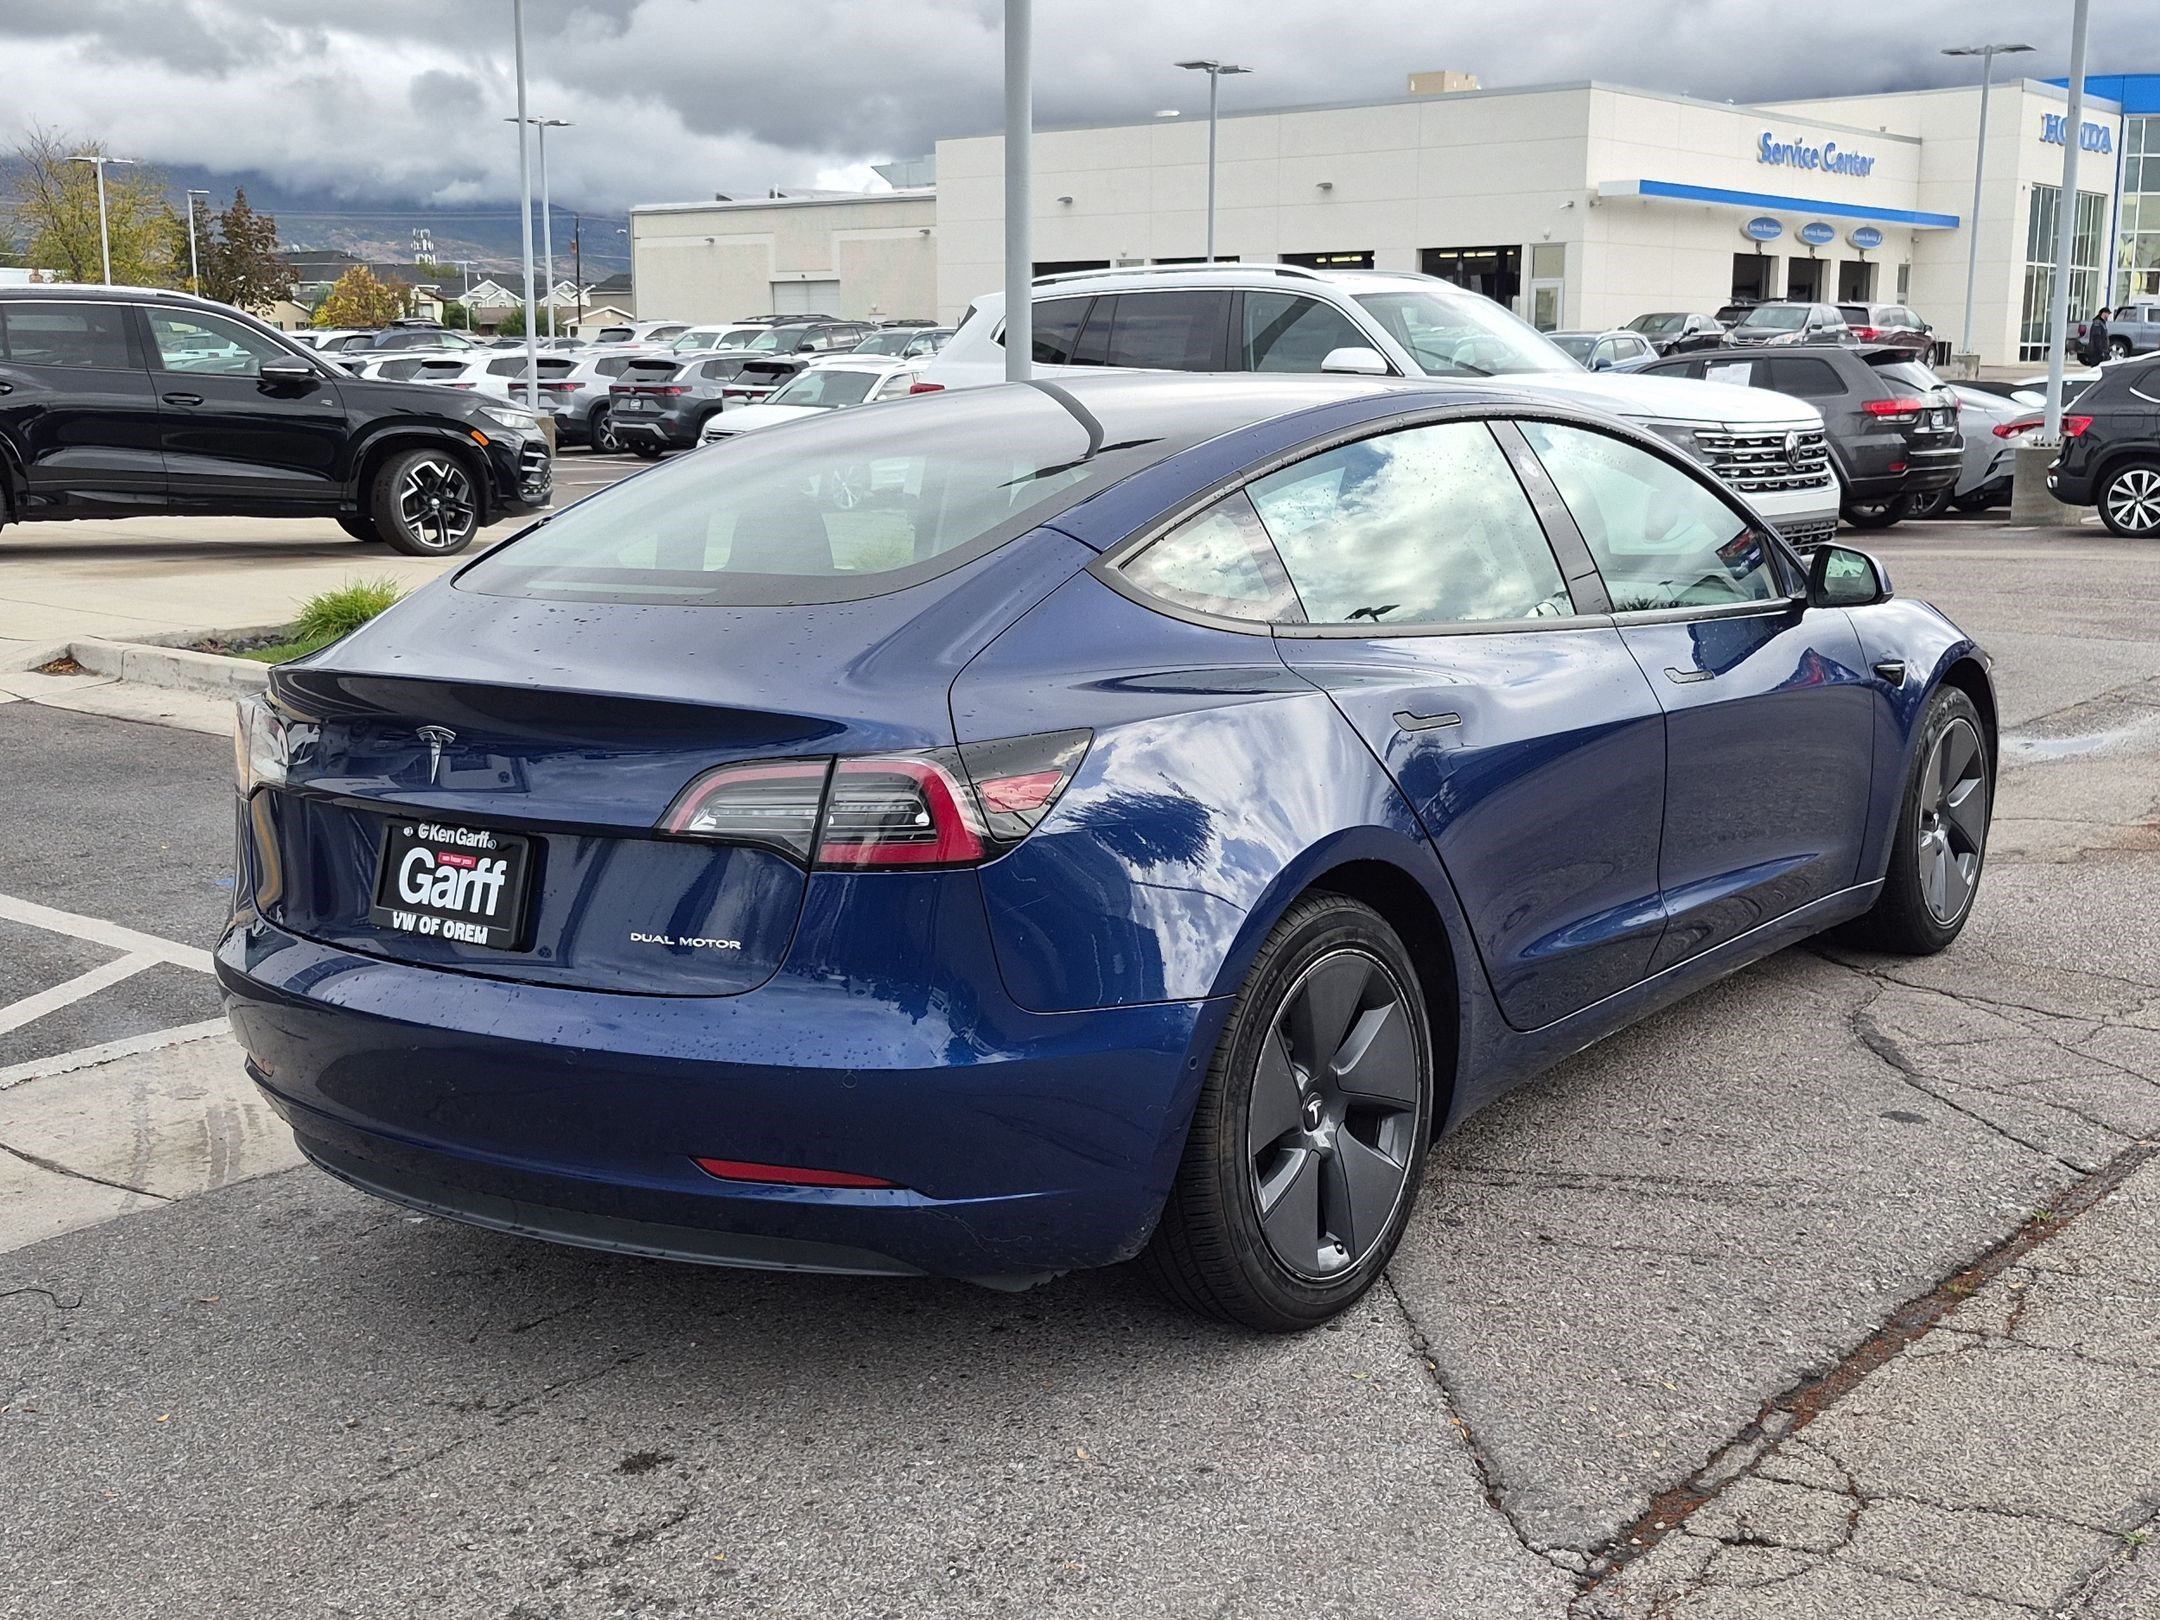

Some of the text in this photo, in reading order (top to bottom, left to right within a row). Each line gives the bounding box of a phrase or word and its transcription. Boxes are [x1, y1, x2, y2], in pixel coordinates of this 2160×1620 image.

[1758, 132, 1875, 177] Service Center
[399, 847, 507, 916] Garff
[392, 912, 488, 945] VW OF OREM
[630, 933, 741, 949] DUAL MOTOR
